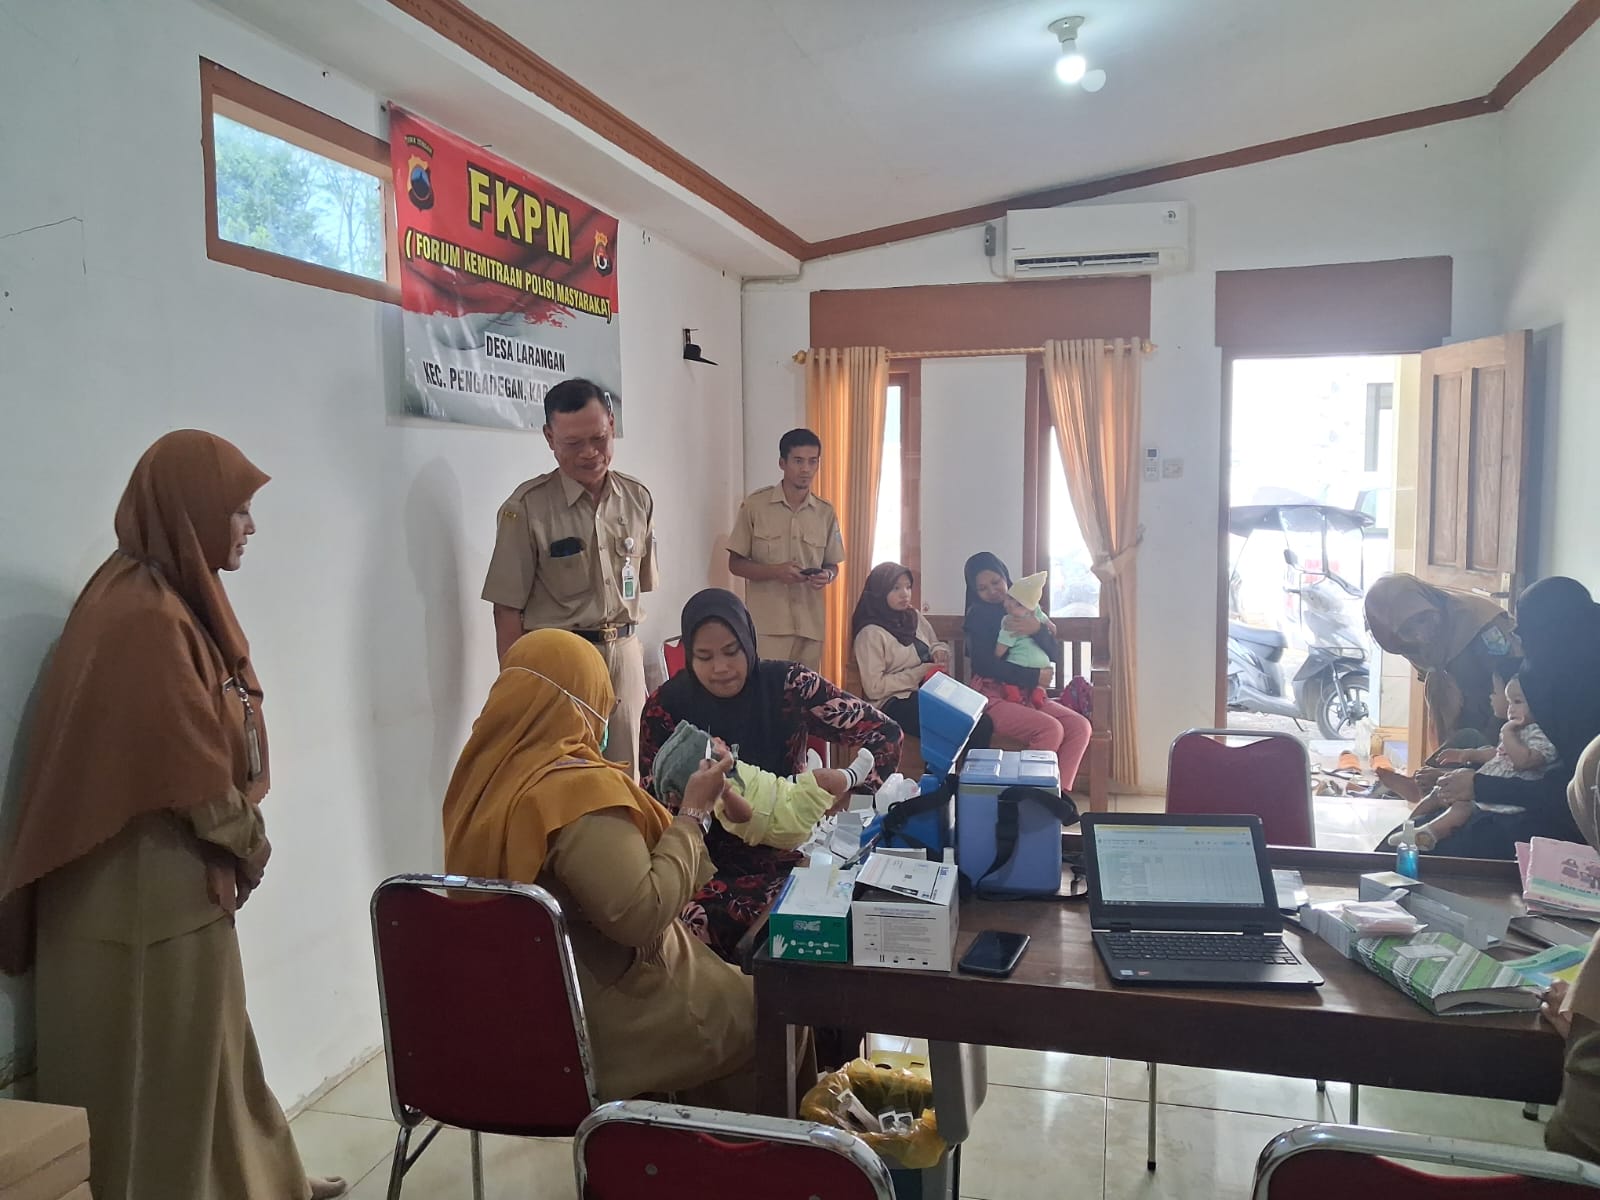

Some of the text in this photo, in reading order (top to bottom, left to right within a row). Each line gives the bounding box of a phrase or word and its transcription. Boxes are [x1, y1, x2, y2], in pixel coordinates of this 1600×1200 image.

[468, 167, 570, 260] FKPM
[463, 249, 522, 290] KEMITRAAN
[525, 271, 555, 300] POLISI
[486, 335, 565, 373] DESA LARANGAN
[423, 360, 447, 388] KEC.
[450, 367, 527, 404] PENGADEGAN,
